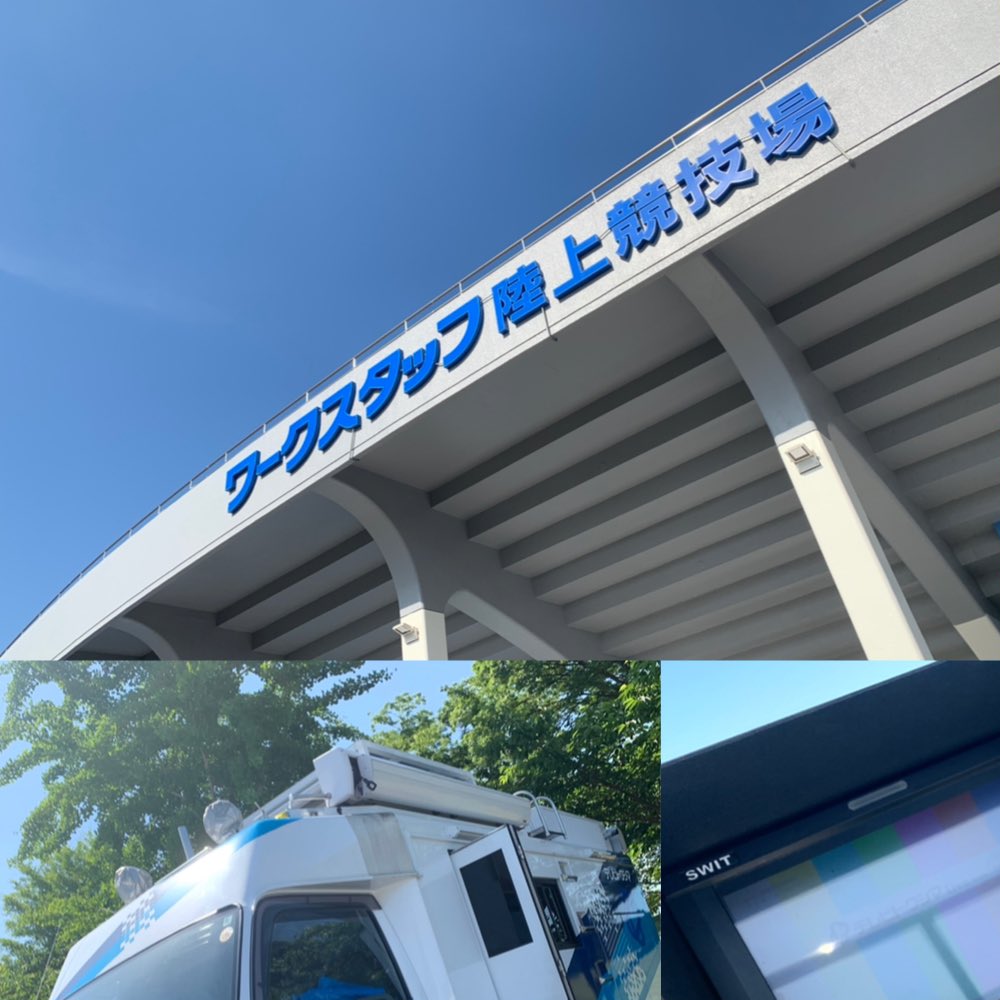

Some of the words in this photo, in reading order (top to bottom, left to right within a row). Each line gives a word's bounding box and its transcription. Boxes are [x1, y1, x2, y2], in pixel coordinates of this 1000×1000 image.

[225, 82, 838, 514] ワークスタッフ陸上競技場
[685, 854, 731, 881] SWIT
